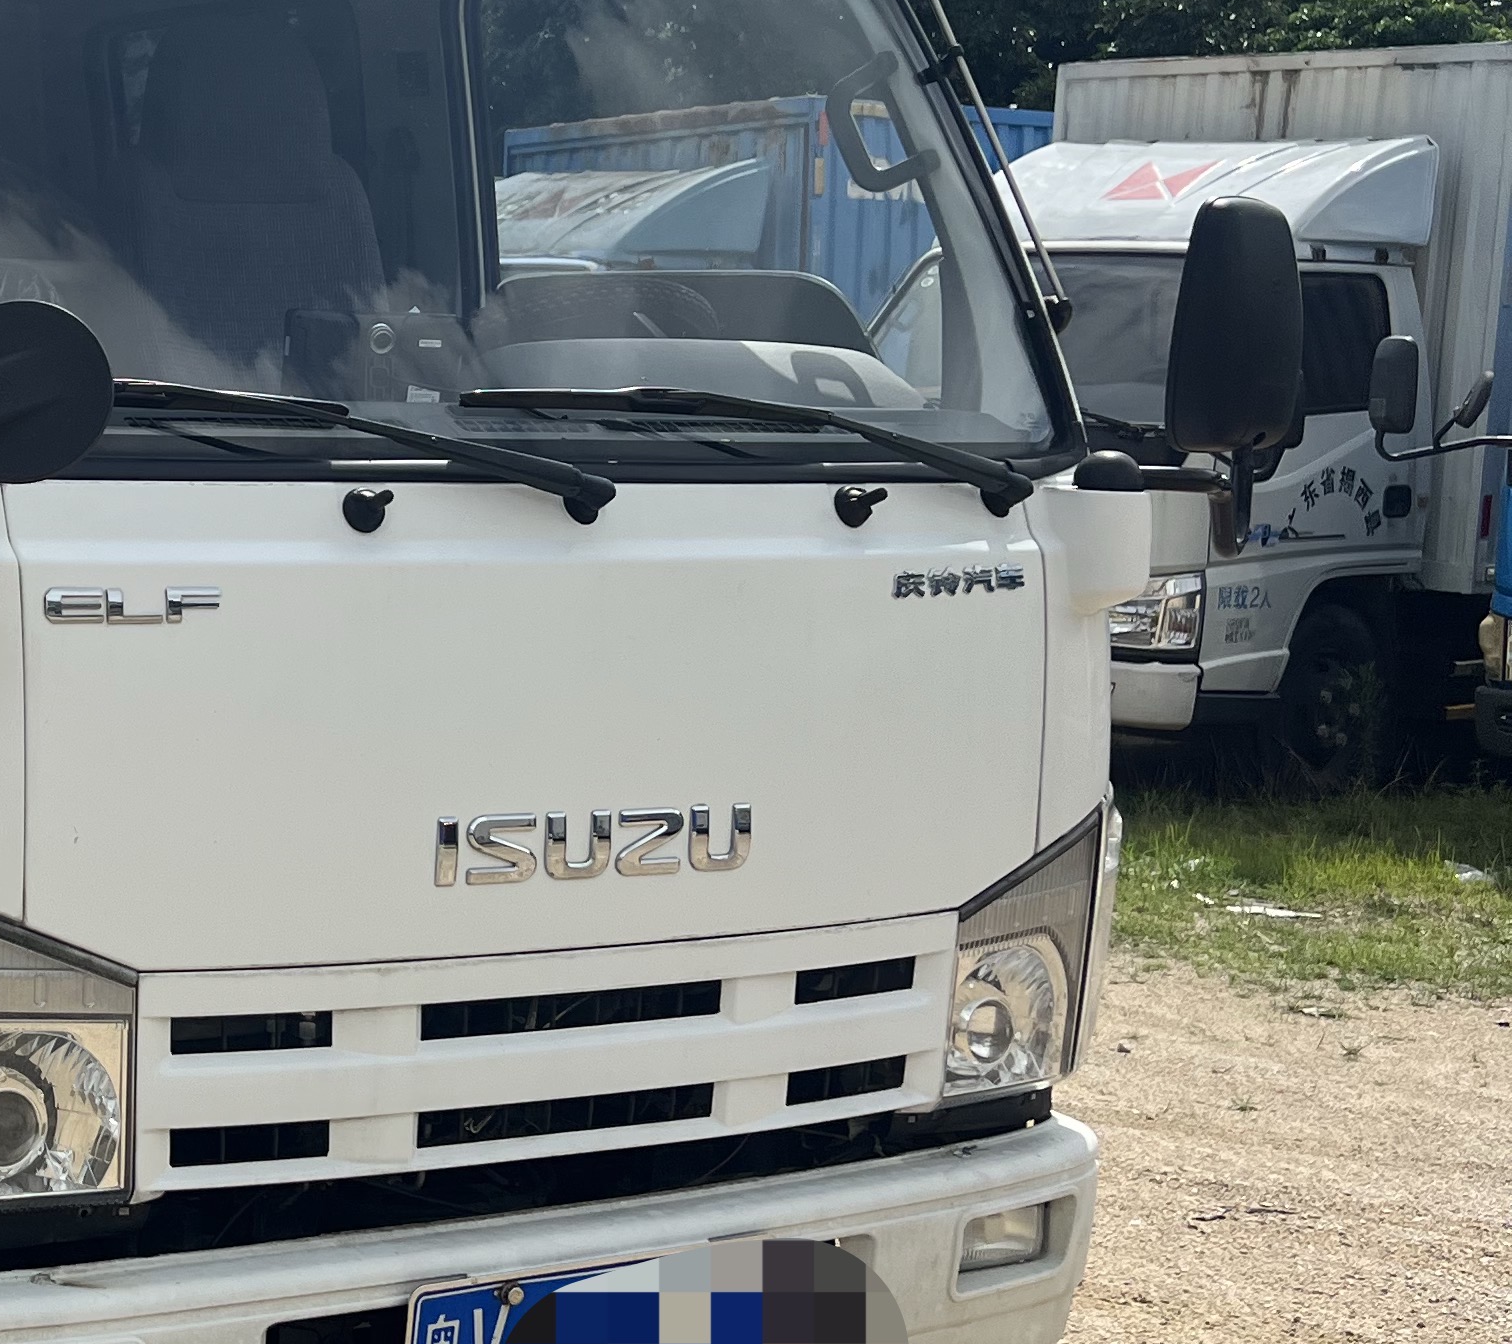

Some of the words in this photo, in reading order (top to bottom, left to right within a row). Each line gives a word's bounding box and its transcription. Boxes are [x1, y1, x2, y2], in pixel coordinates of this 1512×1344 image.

[891, 563, 1025, 599] 庆铃汽车
[44, 586, 222, 624] ELF
[434, 803, 752, 887] ISUZU
